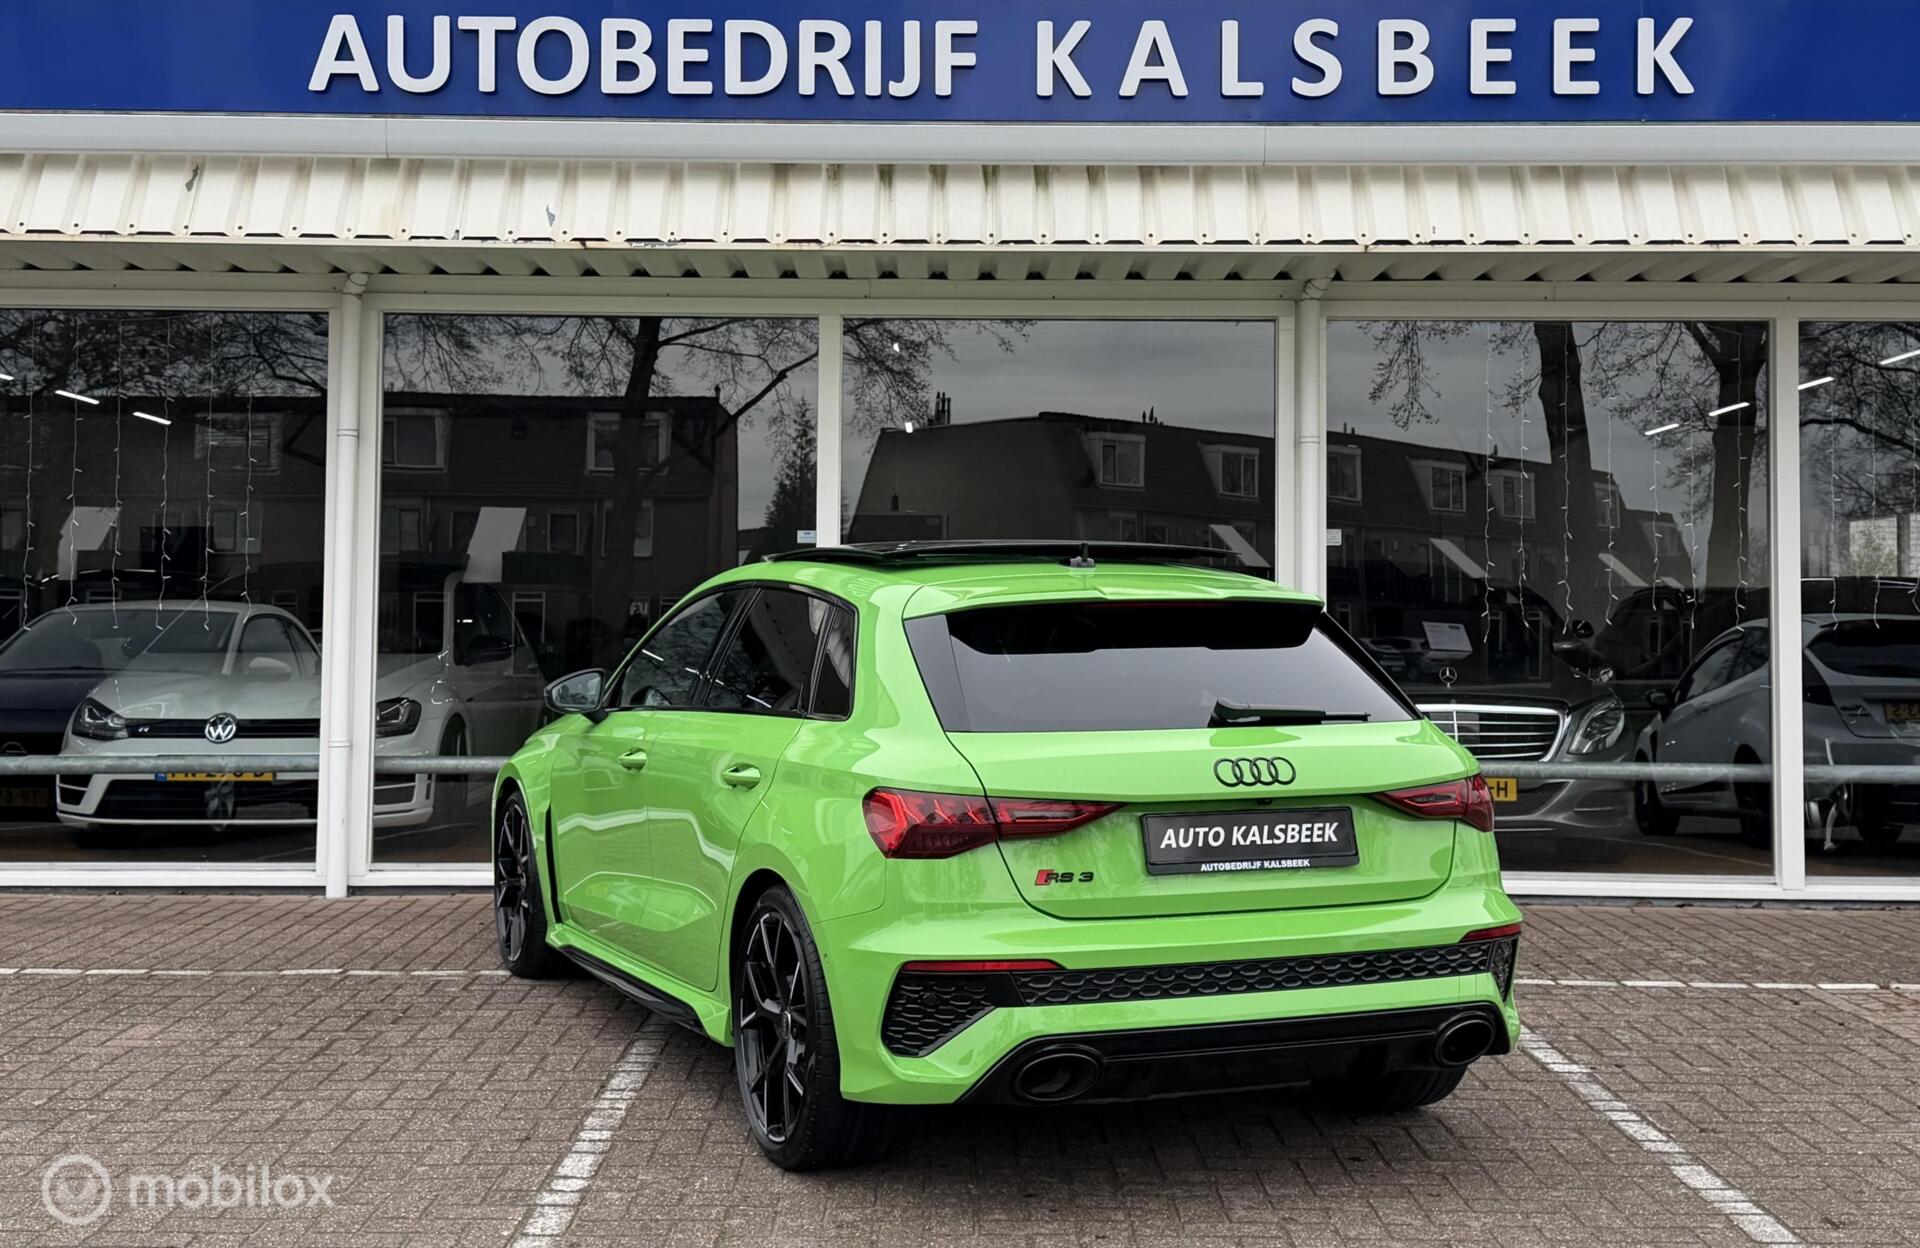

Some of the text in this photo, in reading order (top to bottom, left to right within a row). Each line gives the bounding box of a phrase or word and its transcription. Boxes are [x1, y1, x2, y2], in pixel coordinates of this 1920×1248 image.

[307, 13, 1696, 98] AUTOBEDRIJF KALSBEEK
[1159, 822, 1340, 849] AUTO KALSBEEK
[1200, 858, 1311, 872] AUTOBEDRIJF KALSBEEK
[1038, 870, 1095, 884] RS 3
